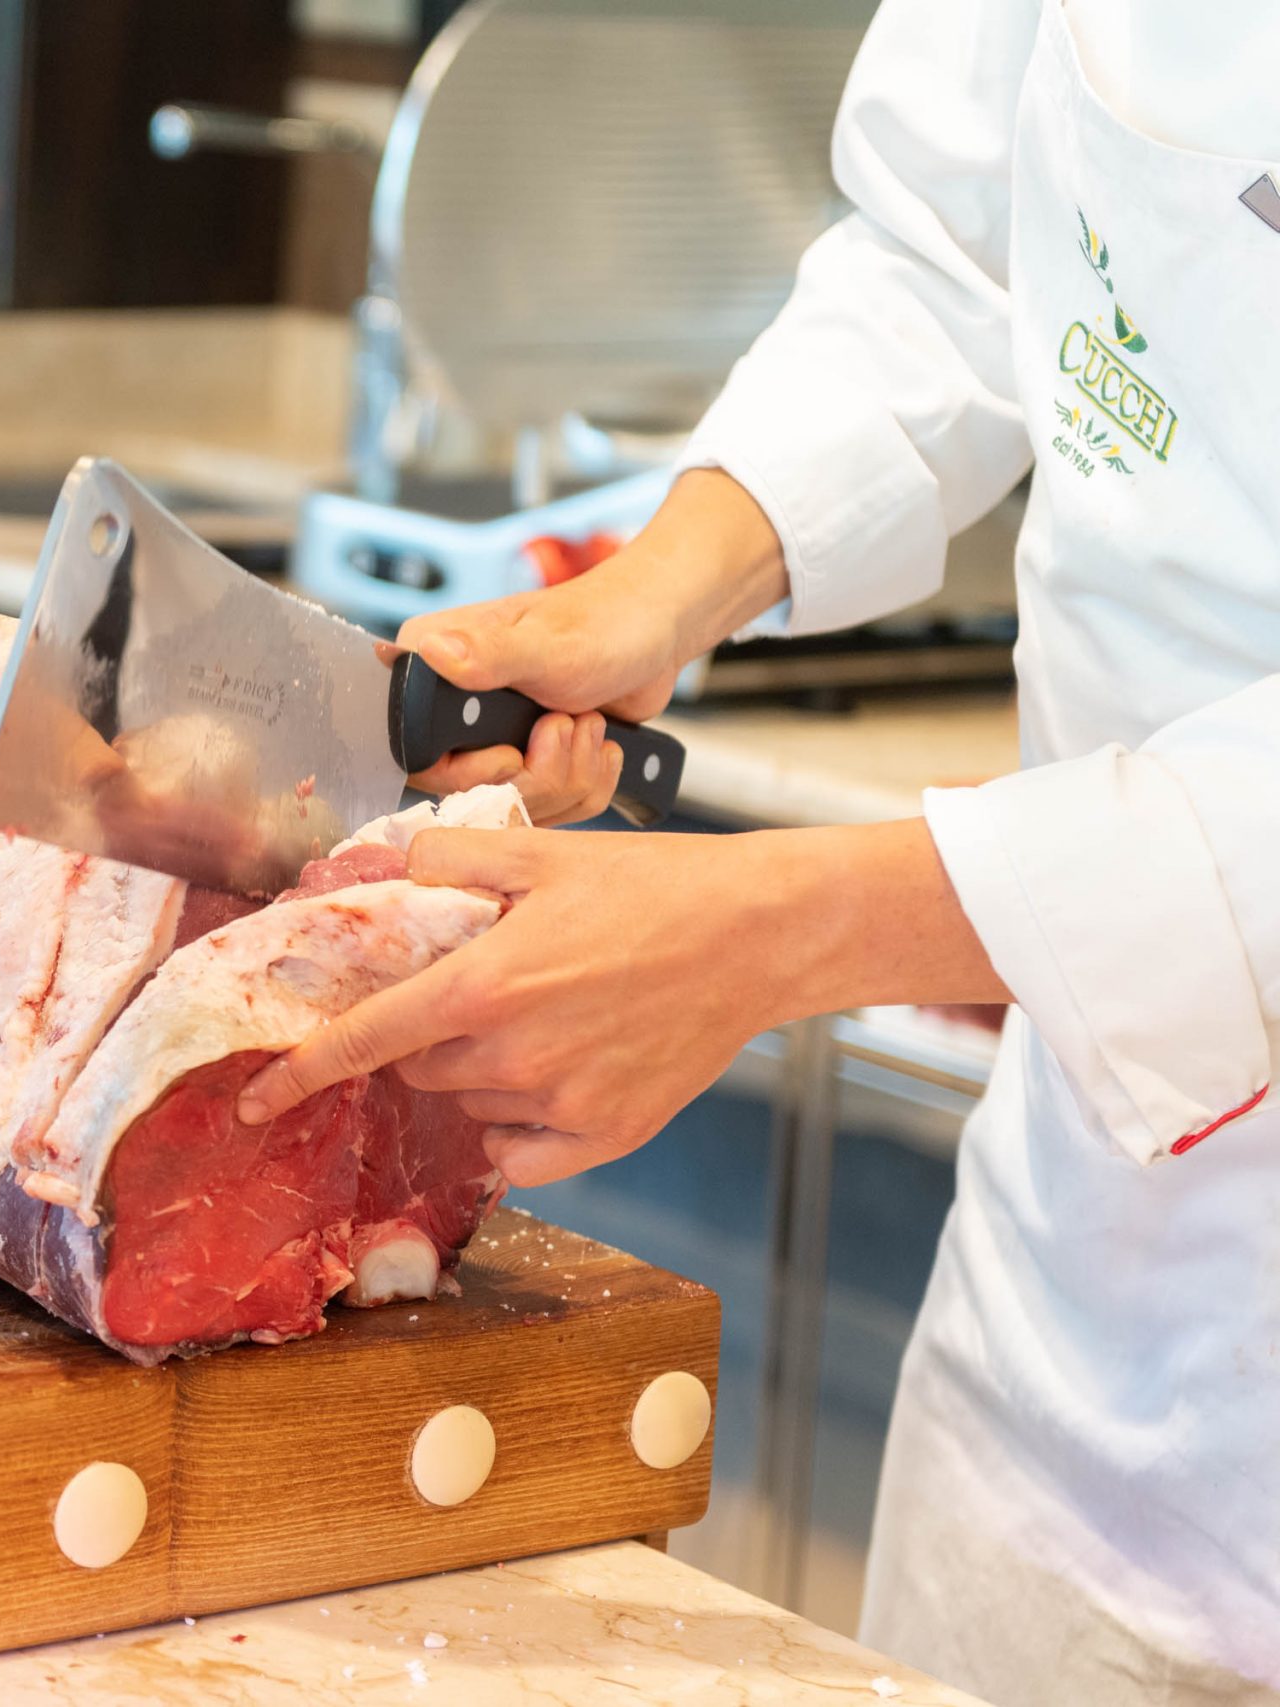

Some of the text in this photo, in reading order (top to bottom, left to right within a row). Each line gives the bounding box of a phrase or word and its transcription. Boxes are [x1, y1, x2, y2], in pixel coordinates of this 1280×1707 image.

[1059, 321, 1179, 464] CUCCHI
[1052, 434, 1096, 478] dal 1984
[243, 680, 273, 702] DICK
